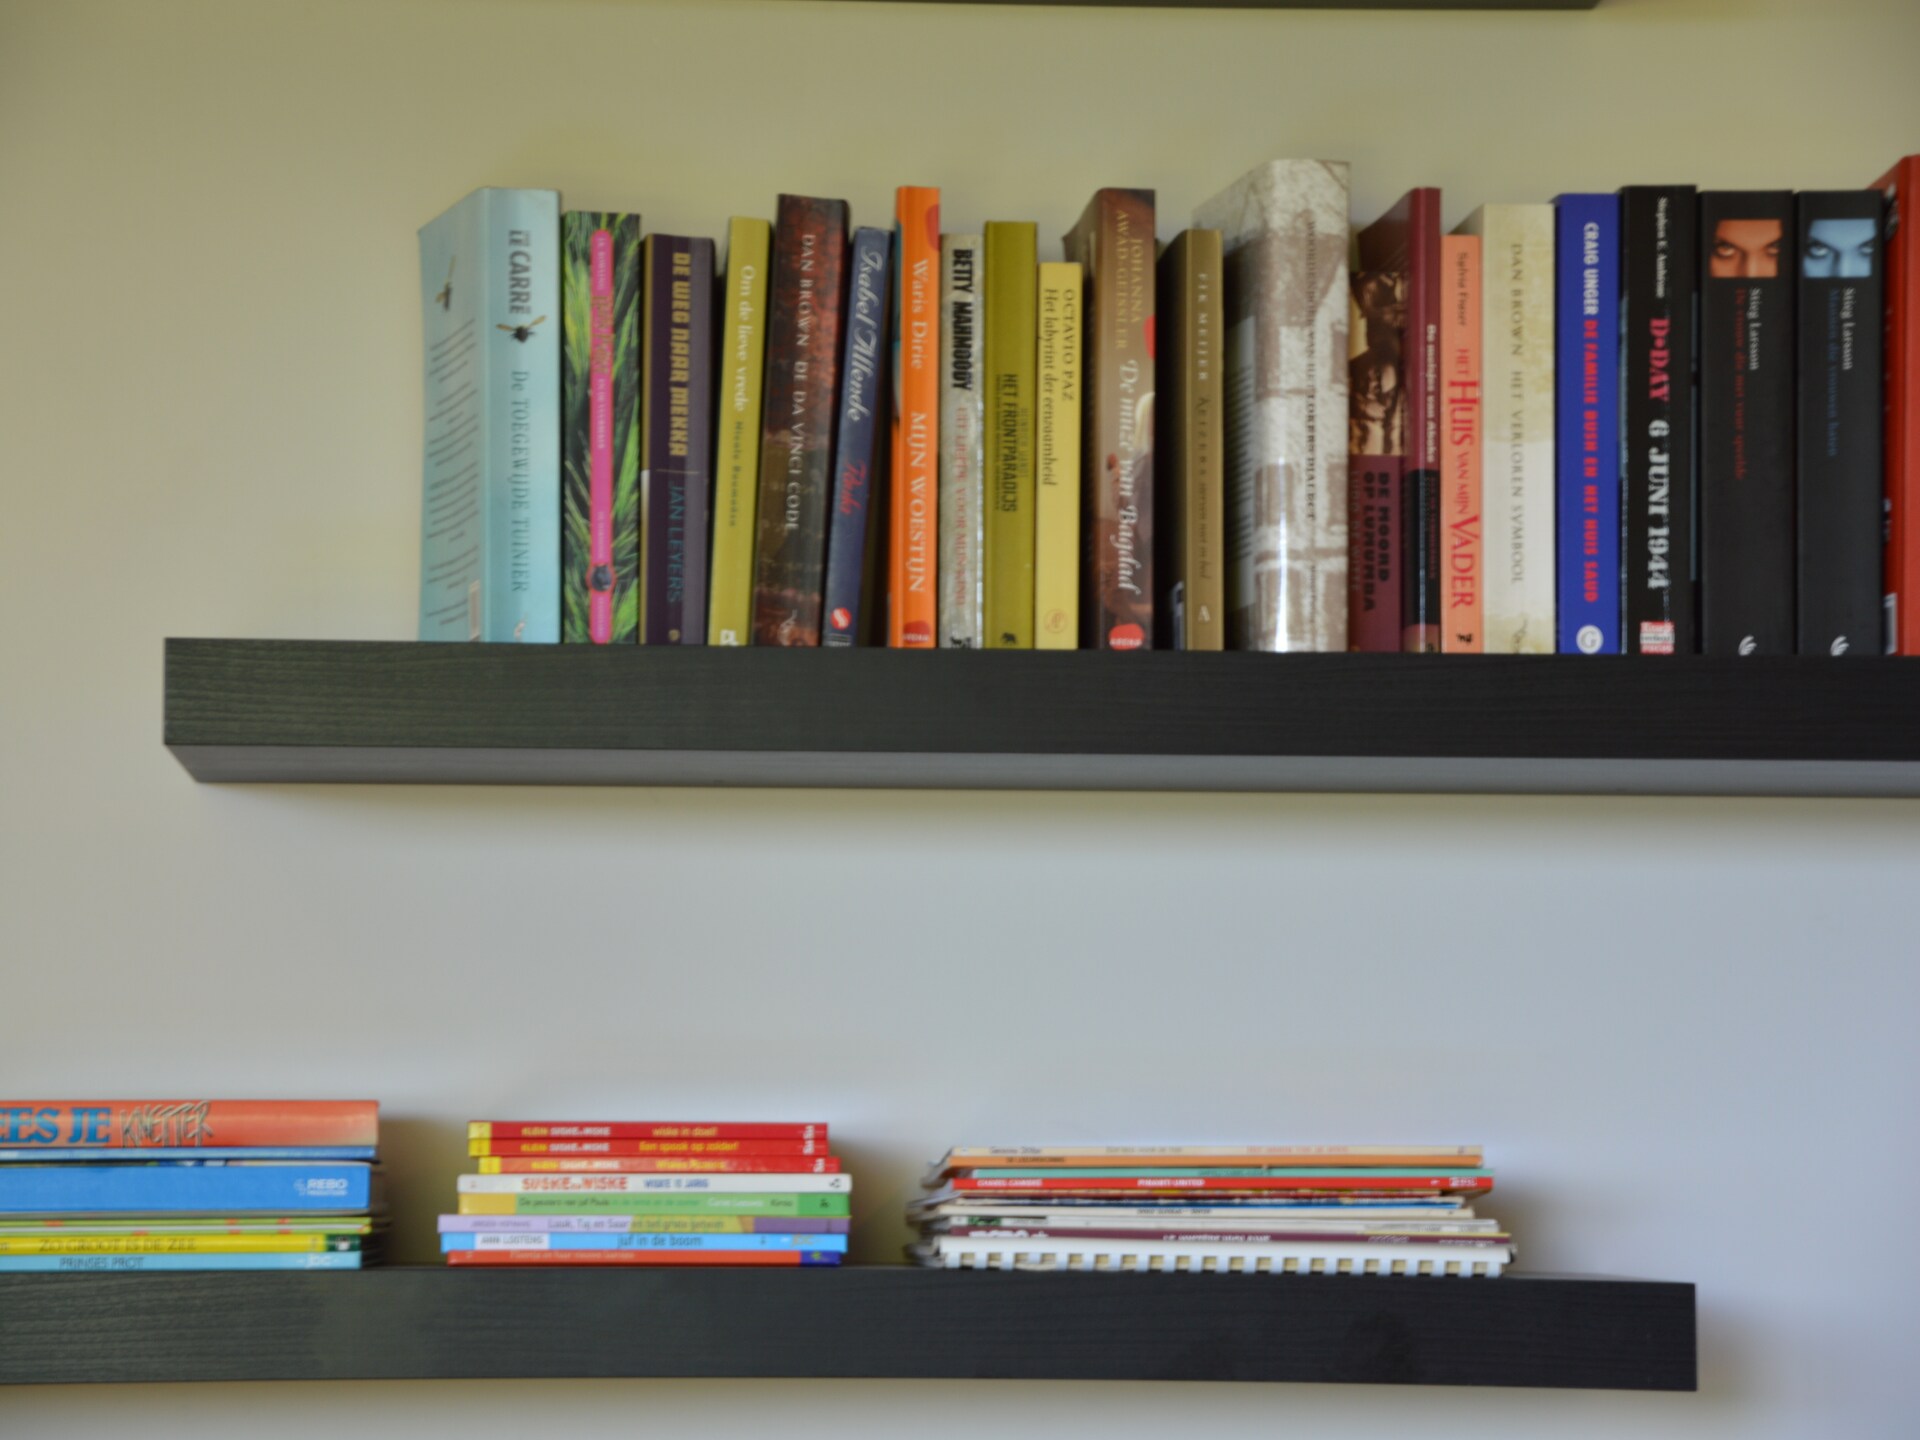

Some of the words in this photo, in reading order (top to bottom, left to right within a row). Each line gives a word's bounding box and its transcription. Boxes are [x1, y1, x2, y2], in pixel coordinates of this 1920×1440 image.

[672, 252, 691, 276] DE
[801, 233, 817, 271] DAN
[1510, 242, 1525, 282] DAN
[1583, 222, 1600, 265] CRAIG
[741, 264, 756, 296] Om
[855, 247, 883, 329] Isabel
[910, 258, 929, 315] Waris
[953, 249, 974, 294] BETTY
[1130, 238, 1144, 323] JOHANNA
[1197, 272, 1210, 304] FIK
[1583, 267, 1600, 317] UNGER
[671, 281, 690, 323] WEG
[739, 301, 754, 321] de
[796, 278, 814, 347] BROWN
[1043, 288, 1060, 314] Het
[1510, 287, 1525, 357] BROWN
[1745, 287, 1763, 321] Stieg
[1839, 287, 1858, 321] Stieg
[737, 325, 753, 362] lieve
[910, 321, 929, 371] Dirie
[953, 301, 974, 392] MAHMOODY
[1038, 317, 1060, 370] labyrint
[1062, 288, 1076, 366] OCTAVIO
[1196, 311, 1210, 382] MEIJER
[1426, 323, 1438, 343] De
[1583, 319, 1599, 340] DE
[1747, 321, 1763, 371] Larsson
[1841, 321, 1858, 371] Larsson
[669, 328, 690, 382] NAAR
[794, 360, 810, 381] DE
[847, 327, 878, 423] Allende
[1119, 359, 1139, 395] De
[1456, 347, 1471, 378] HET
[1583, 342, 1599, 405] FAMILIE
[510, 371, 530, 392] De
[734, 366, 752, 412] vrede
[792, 390, 807, 416] DA
[1001, 373, 1020, 400] HET
[1042, 372, 1060, 394] der
[1062, 368, 1075, 402] PAZ
[1510, 370, 1525, 400] HET
[669, 387, 689, 456] MEKKA
[1119, 397, 1138, 451] muze
[1426, 394, 1437, 420] van
[1447, 379, 1481, 446] HUIS
[1648, 418, 1670, 438] 6
[789, 421, 806, 475] VINCI
[907, 412, 929, 469] MIJN
[1041, 397, 1059, 486] eenzaamheid
[1583, 410, 1599, 452] BUSH
[507, 398, 530, 511] TOEGEWIJDE
[1000, 402, 1020, 513] FRONTPARADIJS
[1456, 450, 1471, 481] VAN
[1509, 408, 1525, 499] VERLOREN
[1583, 457, 1599, 479] EN
[666, 480, 687, 519] JAN
[1118, 459, 1135, 498] van
[1363, 470, 1377, 500] OP
[1377, 471, 1391, 500] DE
[1453, 481, 1471, 516] MIJN
[1583, 484, 1599, 514] HET
[1648, 446, 1670, 517] JUNI
[785, 481, 802, 533] CODE
[510, 517, 530, 592] TUINIER
[905, 475, 928, 594] WOESTIJN
[1109, 503, 1143, 596] Bagdad
[1377, 505, 1391, 583] MOORD
[1510, 504, 1526, 585] SYMBOOL
[1583, 518, 1599, 556] HUIS
[666, 527, 687, 604] LEYERS
[1362, 503, 1377, 613] LUMUMBA
[1448, 513, 1482, 610] VADER
[1646, 524, 1670, 591] 1944
[1583, 561, 1599, 604] SAUD
[66, 1106, 113, 1145] JE
[119, 1099, 215, 1149] KNETTER
[307, 1177, 349, 1190] REBO
[652, 1233, 669, 1247] de
[59, 1256, 109, 1269] PRINSES
